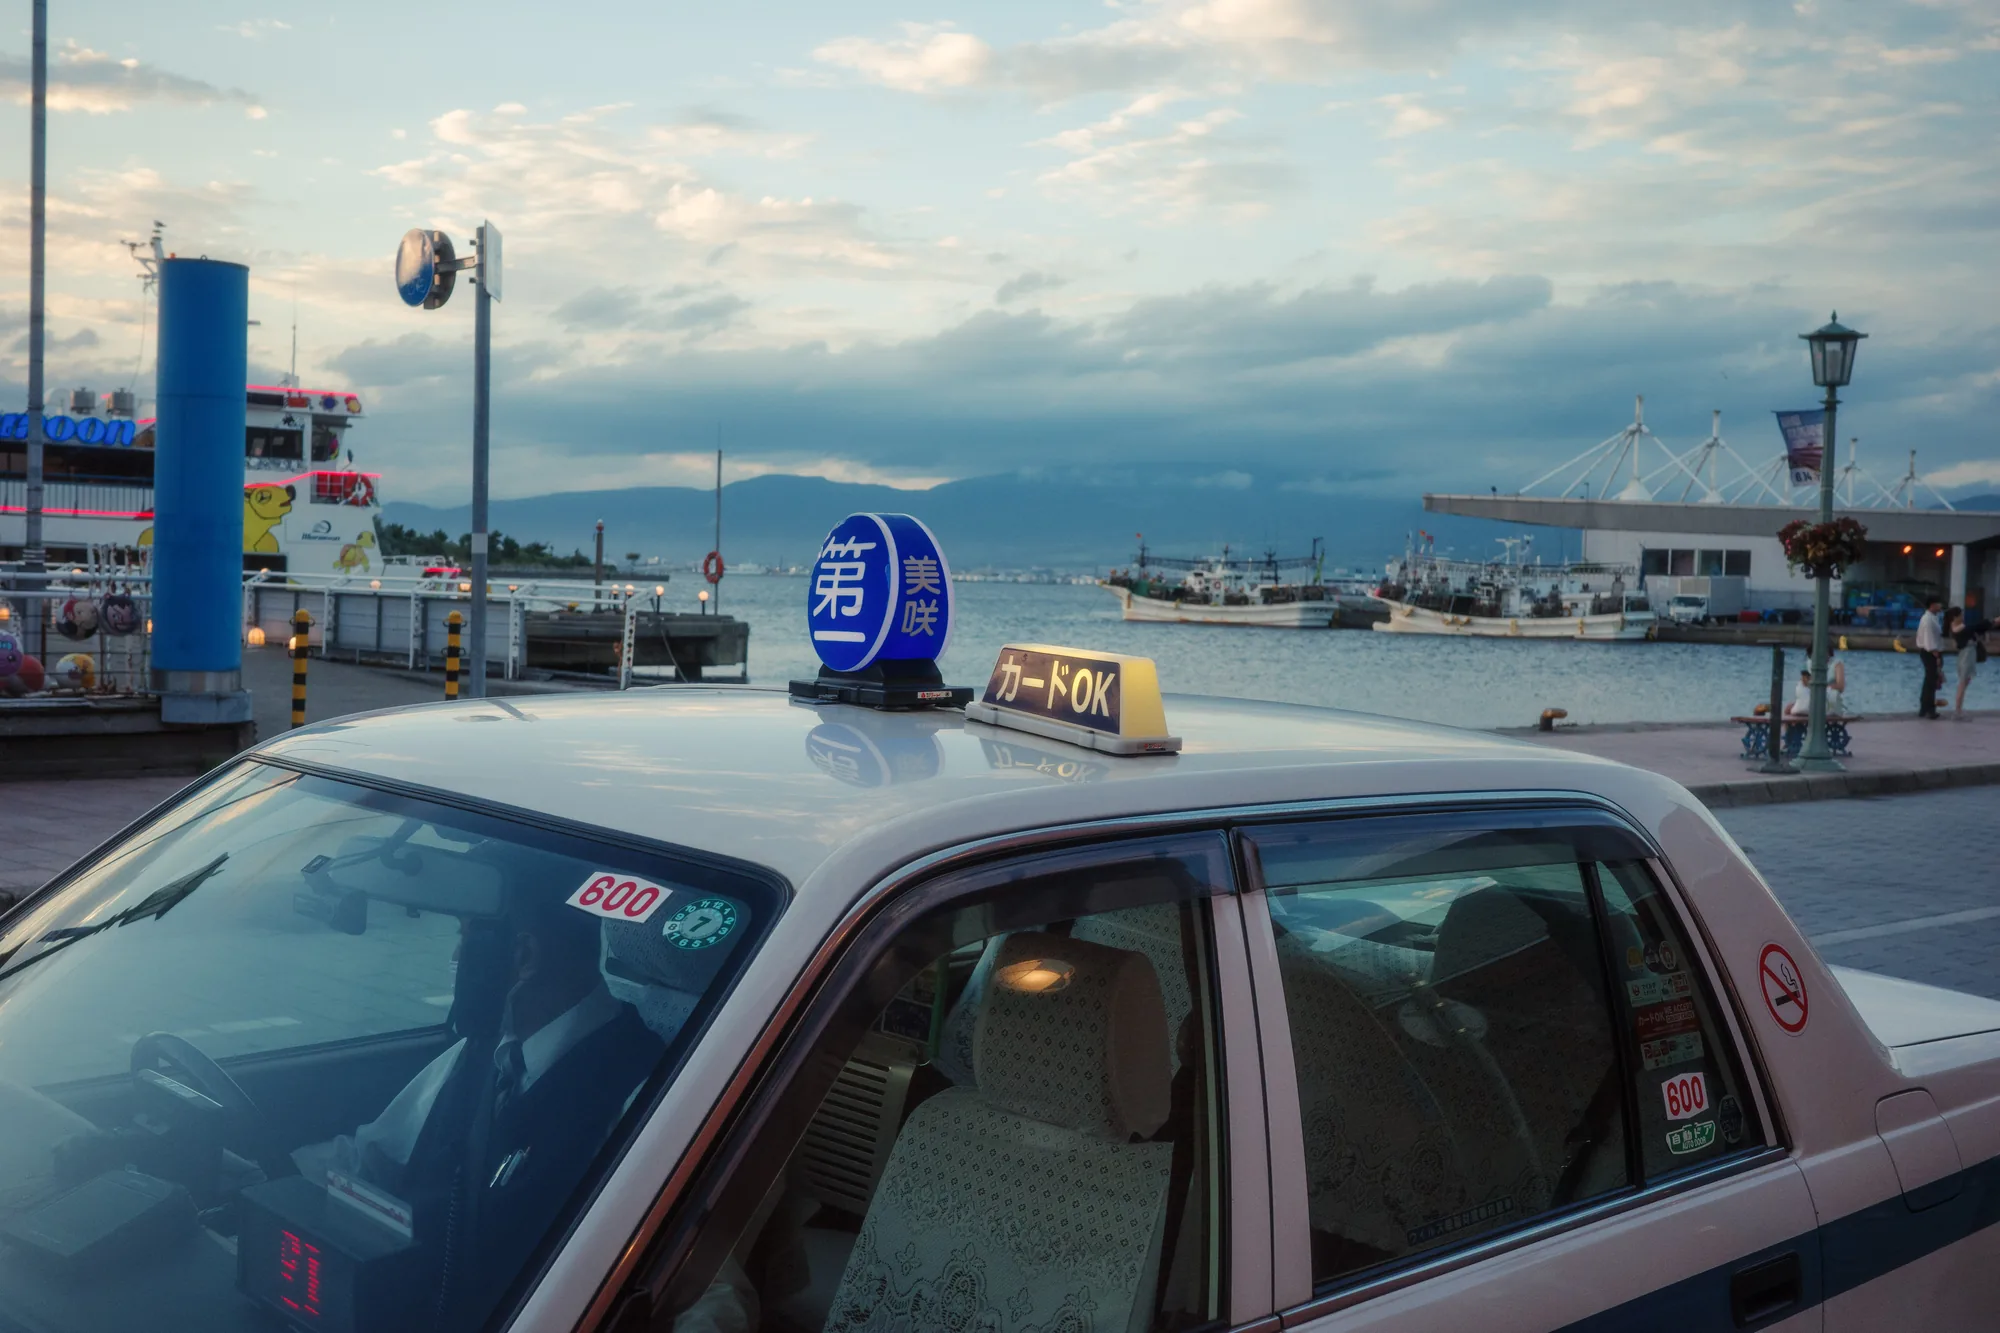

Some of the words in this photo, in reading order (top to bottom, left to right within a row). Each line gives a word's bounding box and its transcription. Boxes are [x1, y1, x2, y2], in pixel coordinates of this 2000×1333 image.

[812, 536, 877, 643] 第一
[901, 555, 941, 637] 美咲
[996, 654, 1116, 718] カードOK
[578, 875, 660, 917] 600
[689, 916, 713, 933] 7
[1667, 1075, 1704, 1117] 600
[1672, 1123, 1713, 1145] 自動ドア
